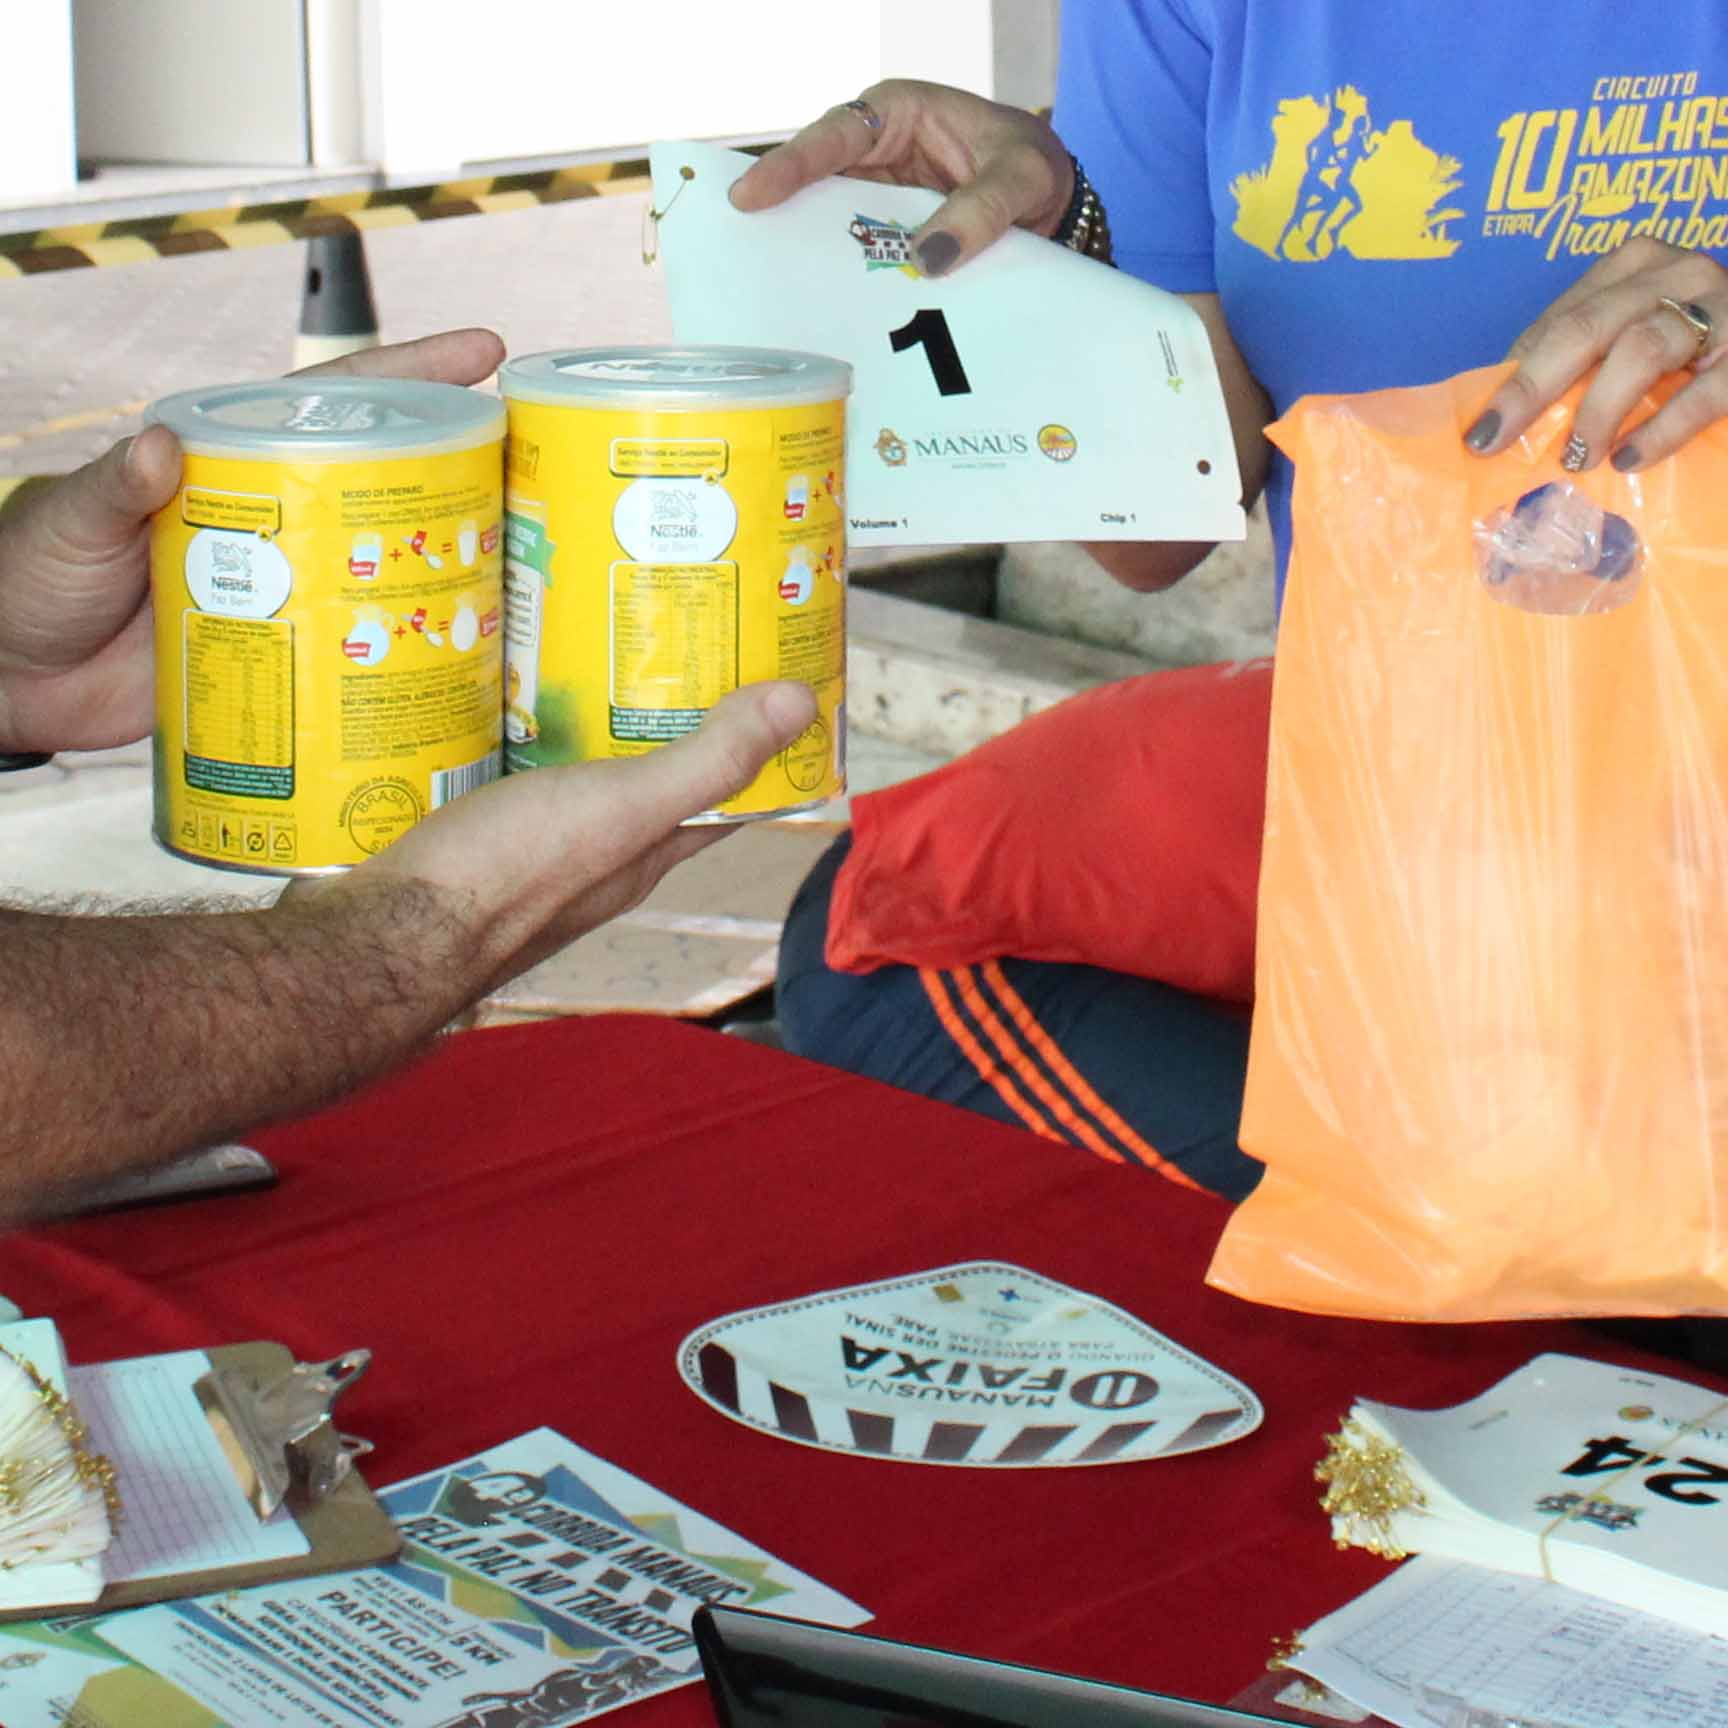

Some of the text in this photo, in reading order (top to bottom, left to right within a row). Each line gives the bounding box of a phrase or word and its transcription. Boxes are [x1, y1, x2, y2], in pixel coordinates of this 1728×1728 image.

[1592, 71, 1698, 101] CIRCUITO
[1486, 108, 1579, 213] 10
[1482, 213, 1536, 237] ETAPA
[889, 308, 972, 398] 1
[913, 433, 1029, 458] MANAUS
[901, 517, 909, 529] 1
[211, 575, 254, 593] Nestlé
[357, 790, 409, 814] BRASIL
[840, 1334, 1068, 1393] FAIXA
[508, 1569, 577, 1596] NO
[316, 1589, 468, 1681] PARTICIPE!
